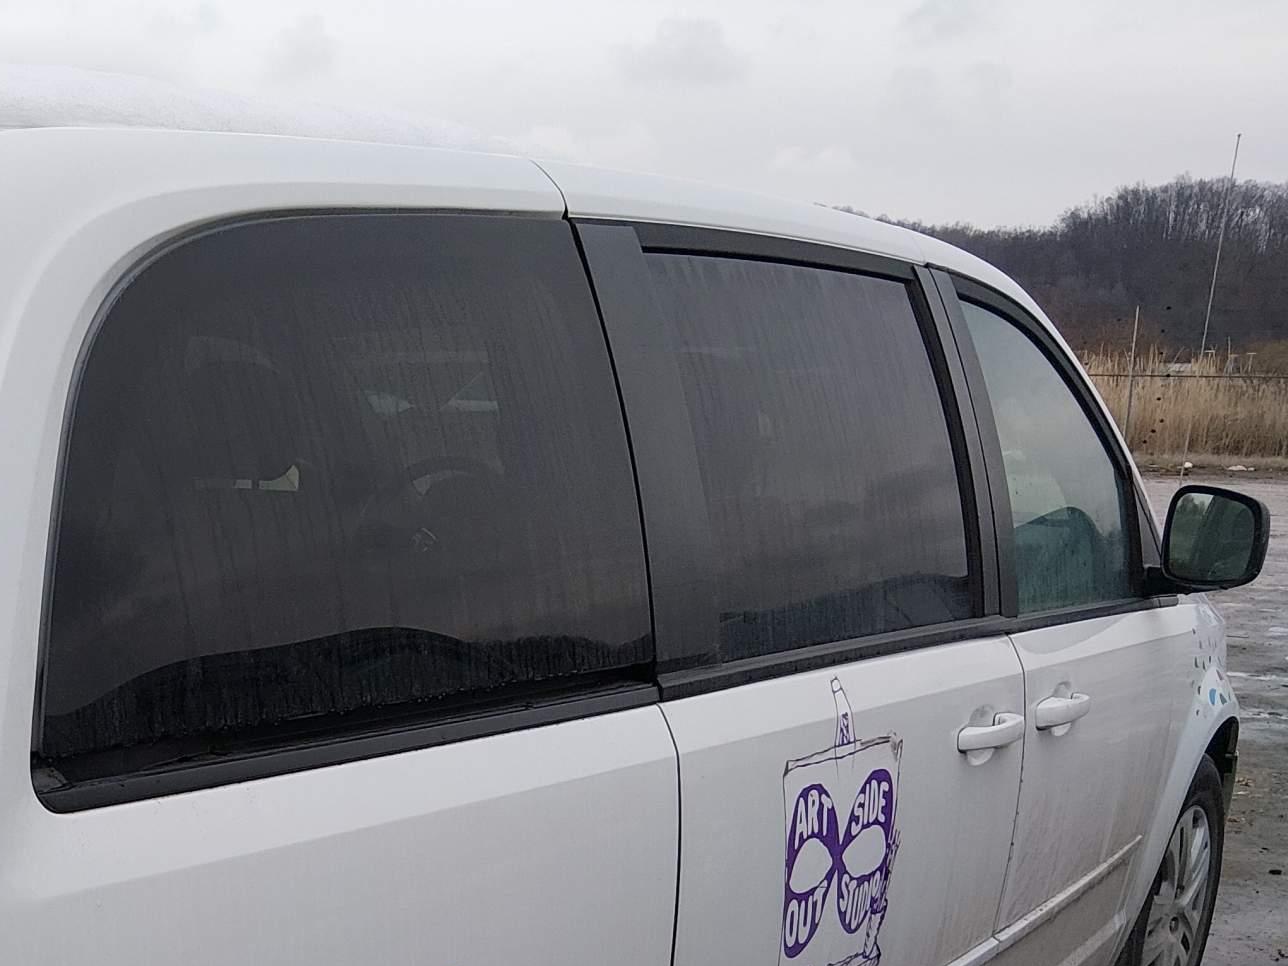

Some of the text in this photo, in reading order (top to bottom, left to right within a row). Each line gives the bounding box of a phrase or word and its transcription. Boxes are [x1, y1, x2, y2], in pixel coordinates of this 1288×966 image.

[796, 779, 889, 849] ART SIDE
[785, 882, 827, 948] OUT
